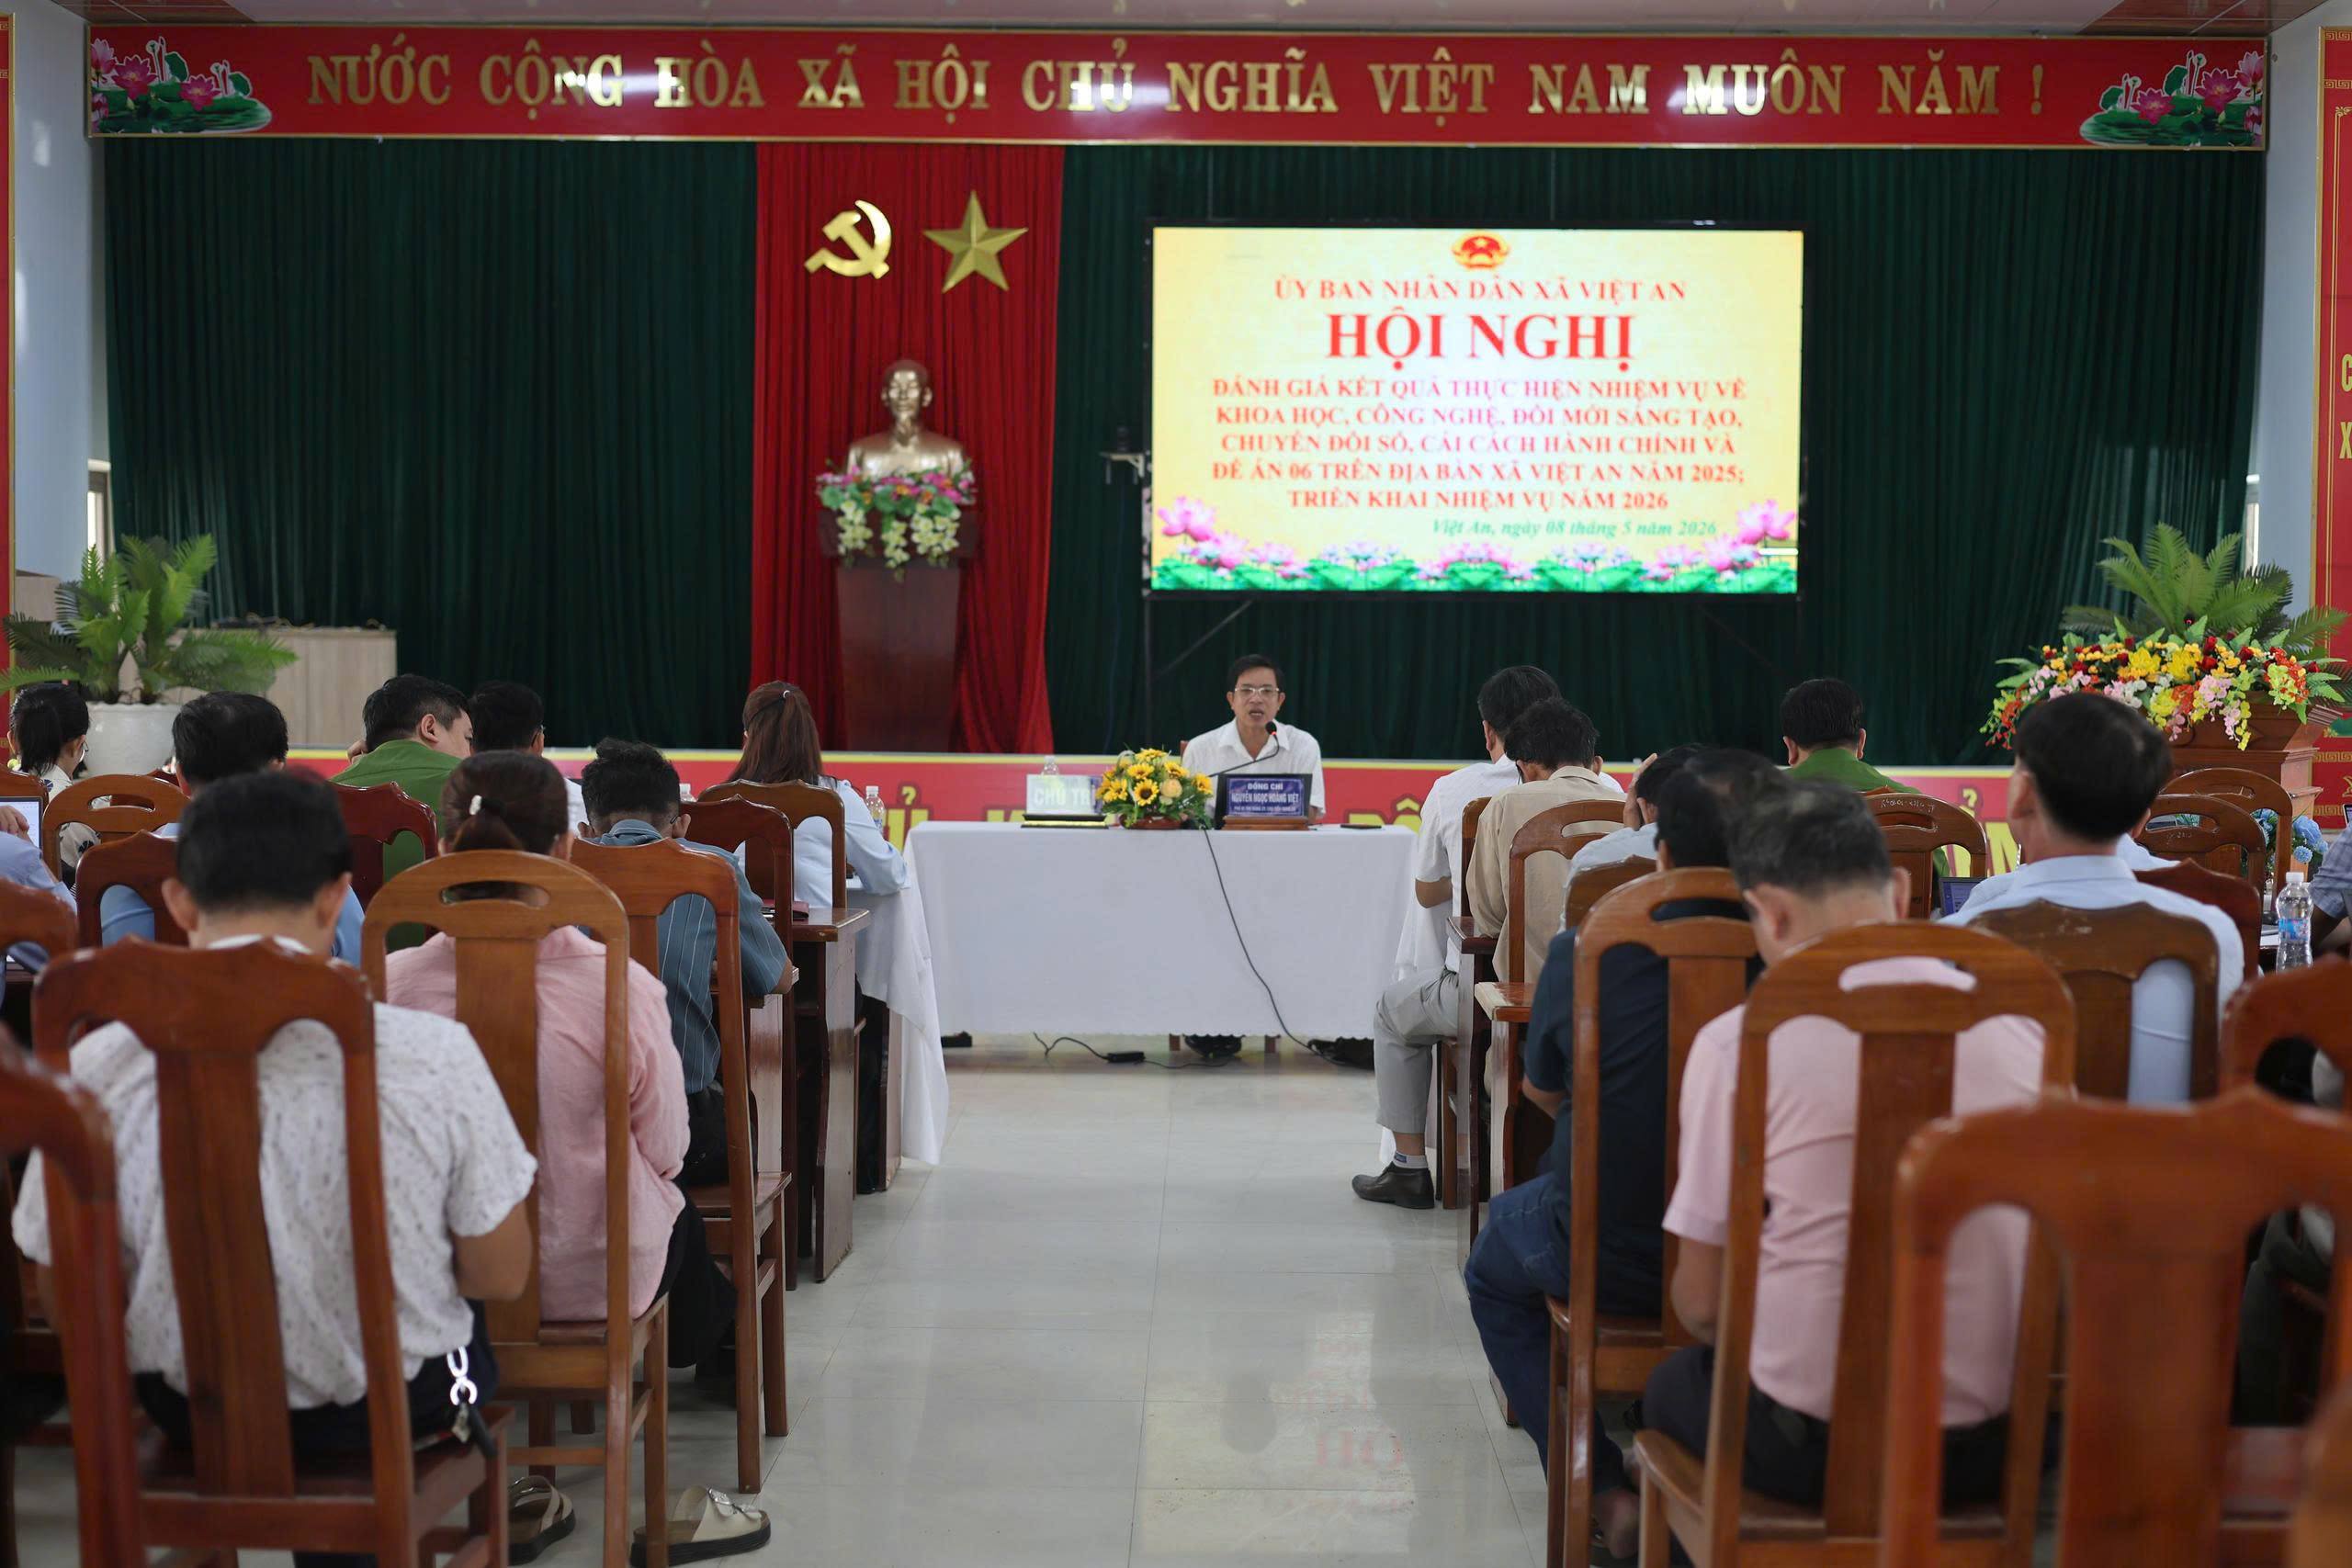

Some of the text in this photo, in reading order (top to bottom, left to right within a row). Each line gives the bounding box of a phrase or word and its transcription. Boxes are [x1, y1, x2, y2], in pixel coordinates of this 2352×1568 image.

[307, 33, 2042, 126] NƯỚC CỘNG HÒA XÃ HỘI CHỦ NGHĨA VIỆT NAM MUÔN NĂM !
[1275, 276, 1687, 304] ỦY BAN NHÂN DÂN XÃ VIỆT AN
[1326, 306, 1634, 371] HỘI NGHỊ
[1214, 375, 1747, 401] ĐÁNH GIÁ KẾT QUẢ THỰC HIỆN NHIỆM VỤ VỀ
[1216, 404, 1742, 429] KHOA HỌC, CÔNG NGHỆ, ĐỔI MỚI SÁNG TẠO,
[1221, 432, 1735, 454] CHUYỂN ĐỔI SỐ, CẢI CÁCH HÀNH CHÍNH VÀ
[1213, 458, 1744, 484] ĐỀ ÁN 06 TRÊN ĐỊA BÀN XÃ VIỆT AN NĂM 2025;
[1288, 487, 1668, 511] TRIỂN KHAI NHIỆM VỤ NĂM 2026
[1432, 516, 1716, 538] Việt An, ngày 08 tháng 5 năm 2026
